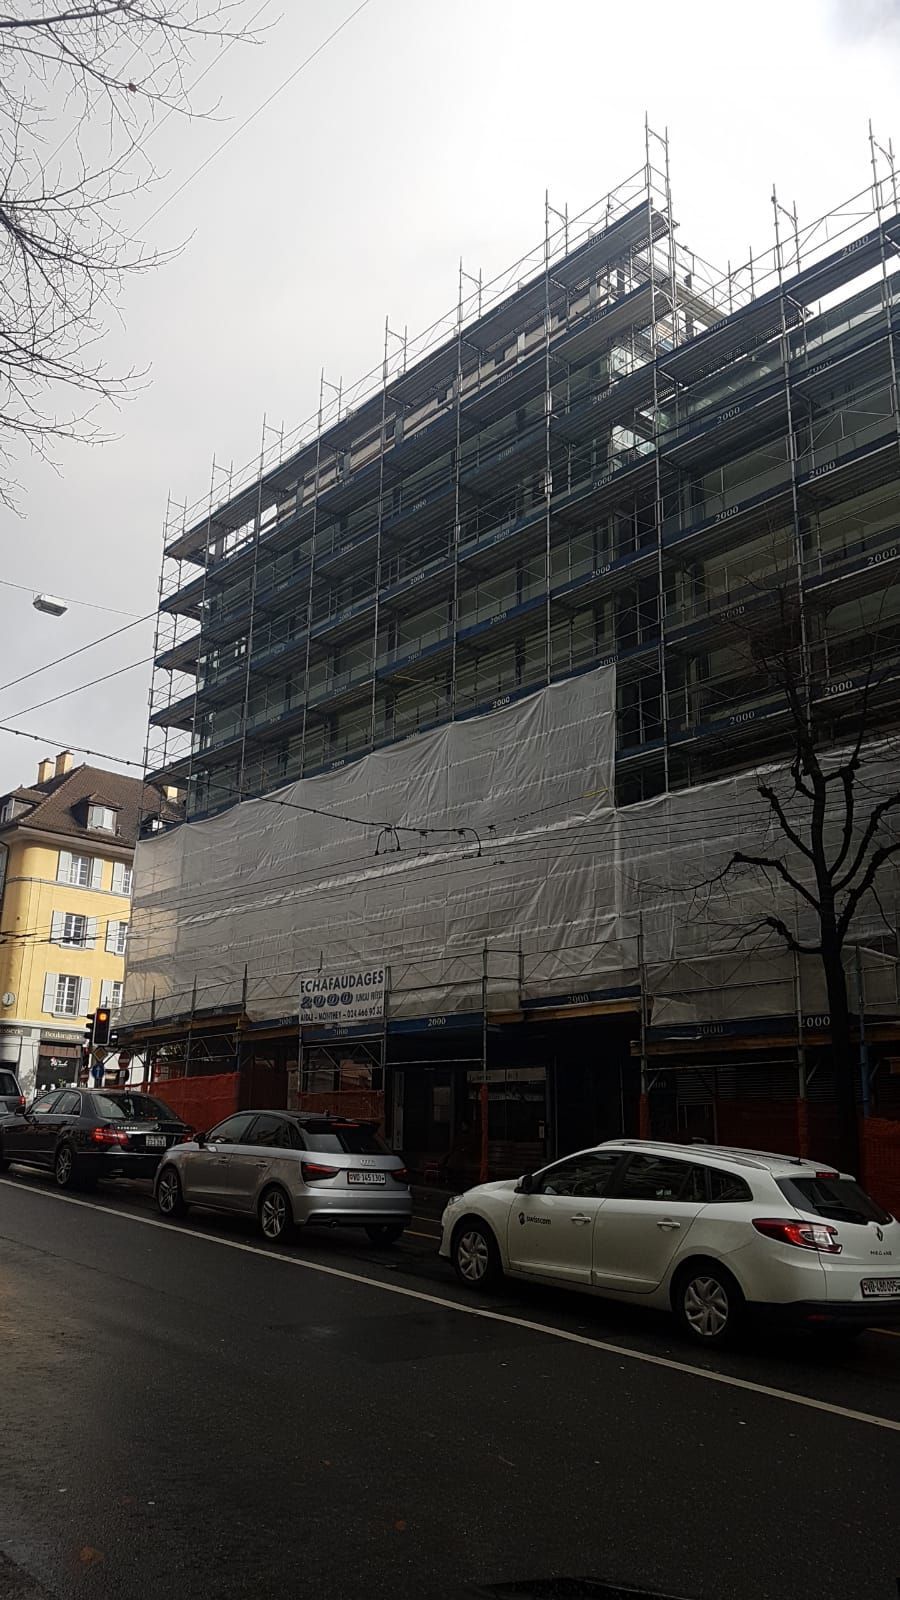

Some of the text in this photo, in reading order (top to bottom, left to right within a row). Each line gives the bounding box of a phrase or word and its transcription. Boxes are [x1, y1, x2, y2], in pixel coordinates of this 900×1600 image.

[842, 236, 869, 256] 2000
[717, 407, 741, 424] 2000
[809, 461, 836, 479] 2000
[592, 475, 613, 489] 2000
[715, 506, 739, 523] 2000
[867, 548, 897, 566] 2000
[591, 564, 611, 578] 2000
[720, 605, 745, 622] 2000
[824, 680, 853, 697] 2000
[492, 696, 511, 708] 2000
[729, 710, 755, 725] 2000
[300, 970, 384, 993] ECHAFAUDAGES
[300, 992, 353, 1009] 2000
[428, 1018, 446, 1026] 2000
[527, 1215, 552, 1225] swisscom
